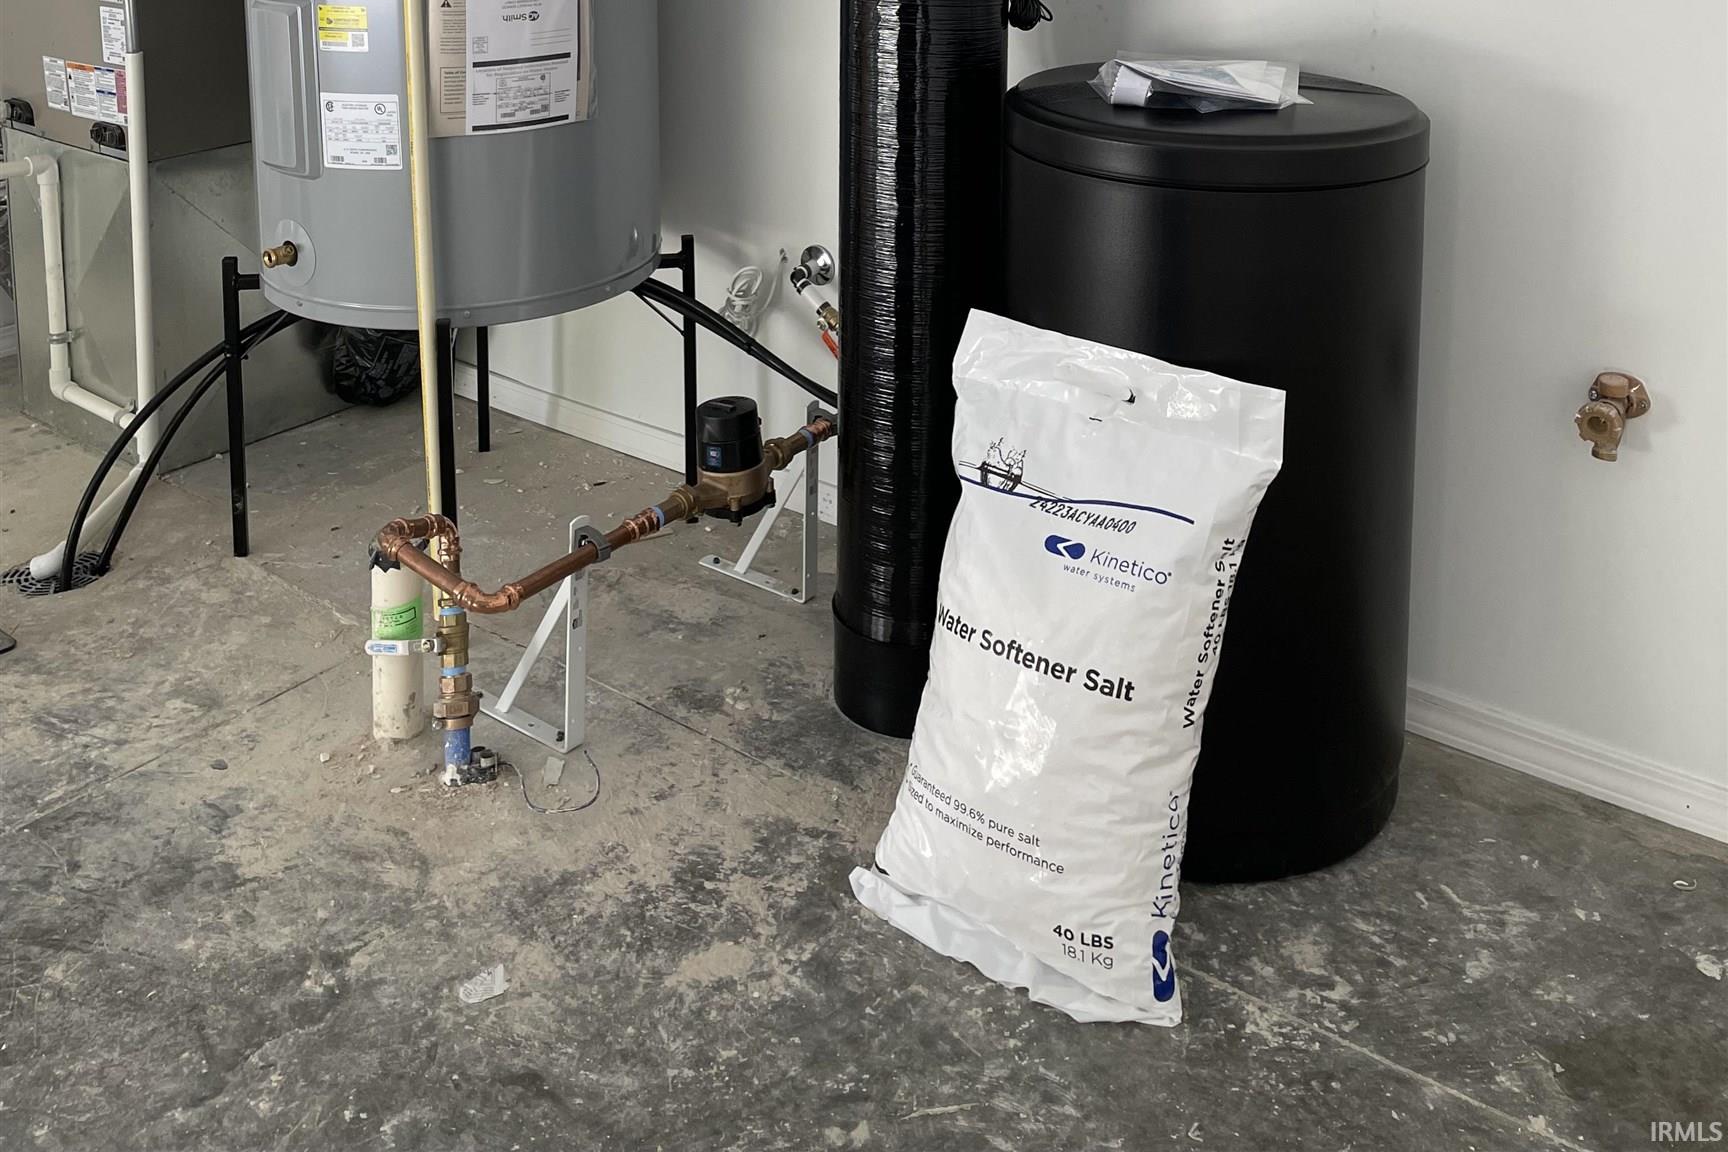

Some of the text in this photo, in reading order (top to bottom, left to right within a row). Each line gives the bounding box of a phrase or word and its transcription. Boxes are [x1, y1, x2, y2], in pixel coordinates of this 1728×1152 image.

[502, 13, 527, 22] Smith
[1063, 563, 1136, 592] water systems
[1090, 548, 1169, 585] Kinetico
[1183, 537, 1236, 728] Water Softener Slt
[938, 602, 1135, 702] Water Softener Salt
[912, 764, 1041, 848] Guaranteed 99.6% pure salt
[925, 797, 934, 812] to
[935, 807, 983, 840] maximize
[986, 835, 1065, 874] performance
[1053, 924, 1114, 949] 40 LBS
[1061, 943, 1114, 969] 18.1 Kg
